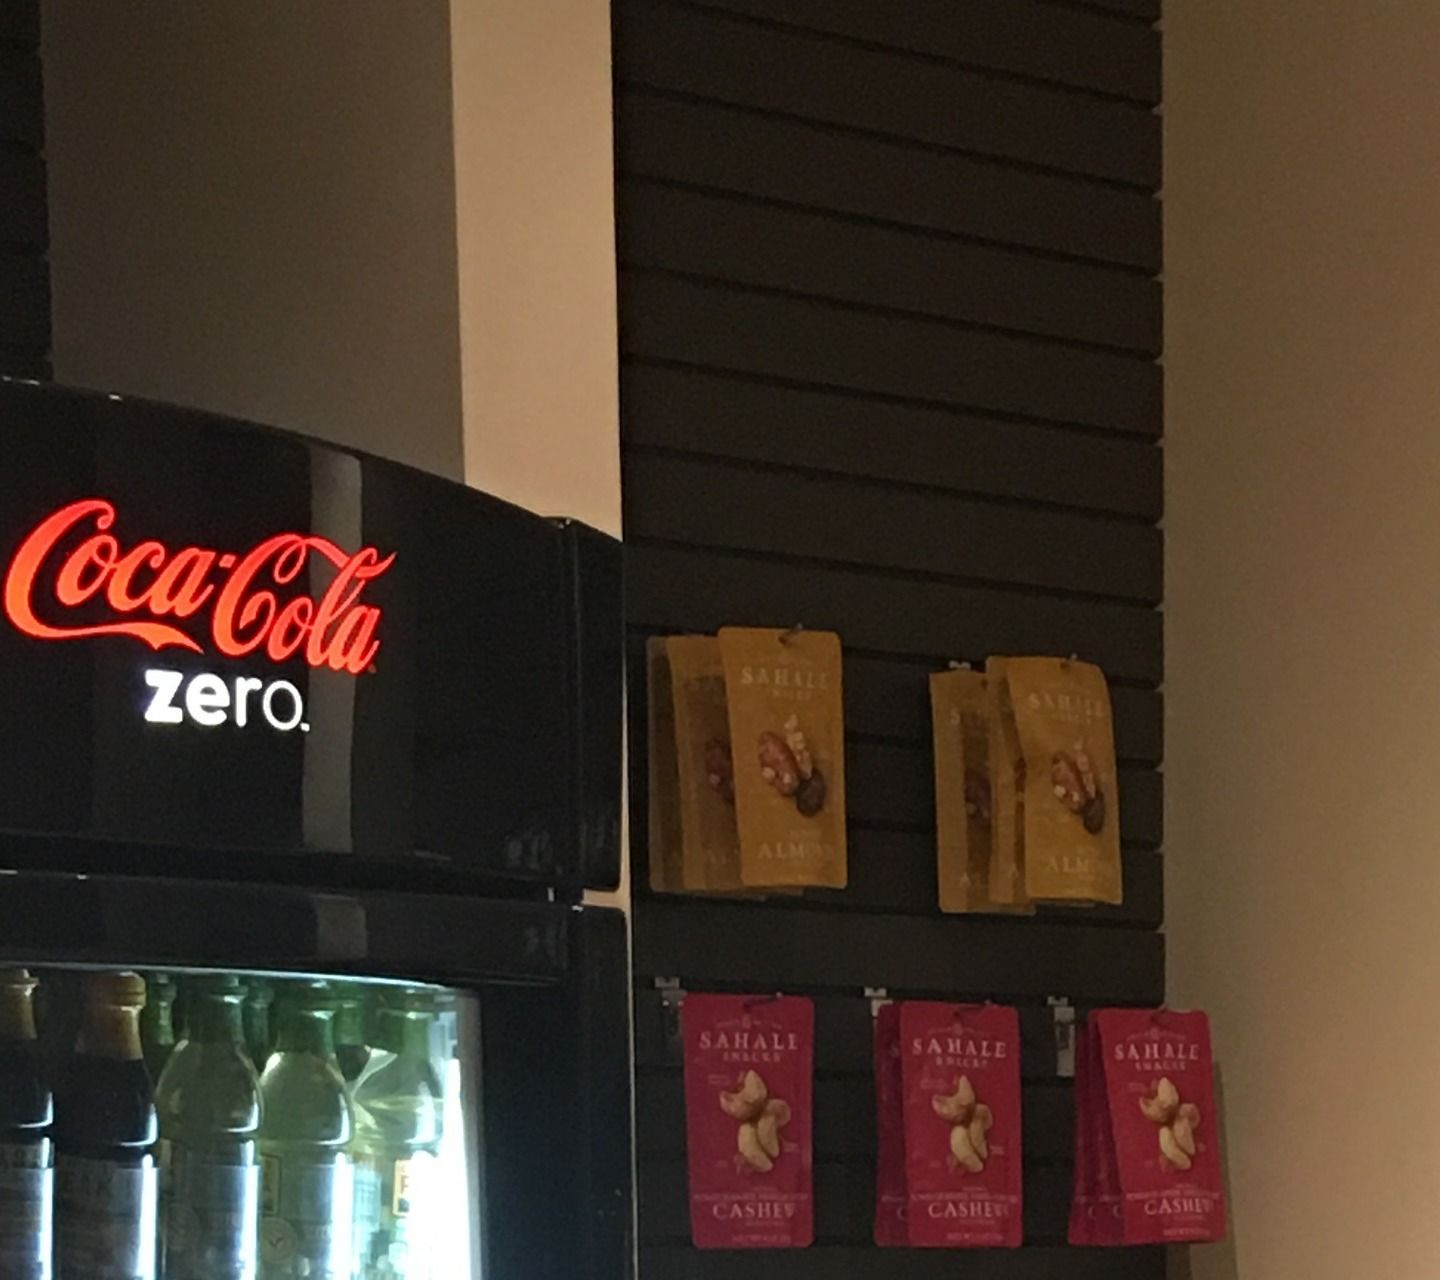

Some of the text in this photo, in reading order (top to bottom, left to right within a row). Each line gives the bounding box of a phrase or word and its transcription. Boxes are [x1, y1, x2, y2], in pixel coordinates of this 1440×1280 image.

[5, 499, 396, 674] Coca-Cola
[699, 1030, 800, 1051] SAHALE
[912, 1037, 1007, 1059] SAHALE
[1114, 1042, 1200, 1060] SAHALE
